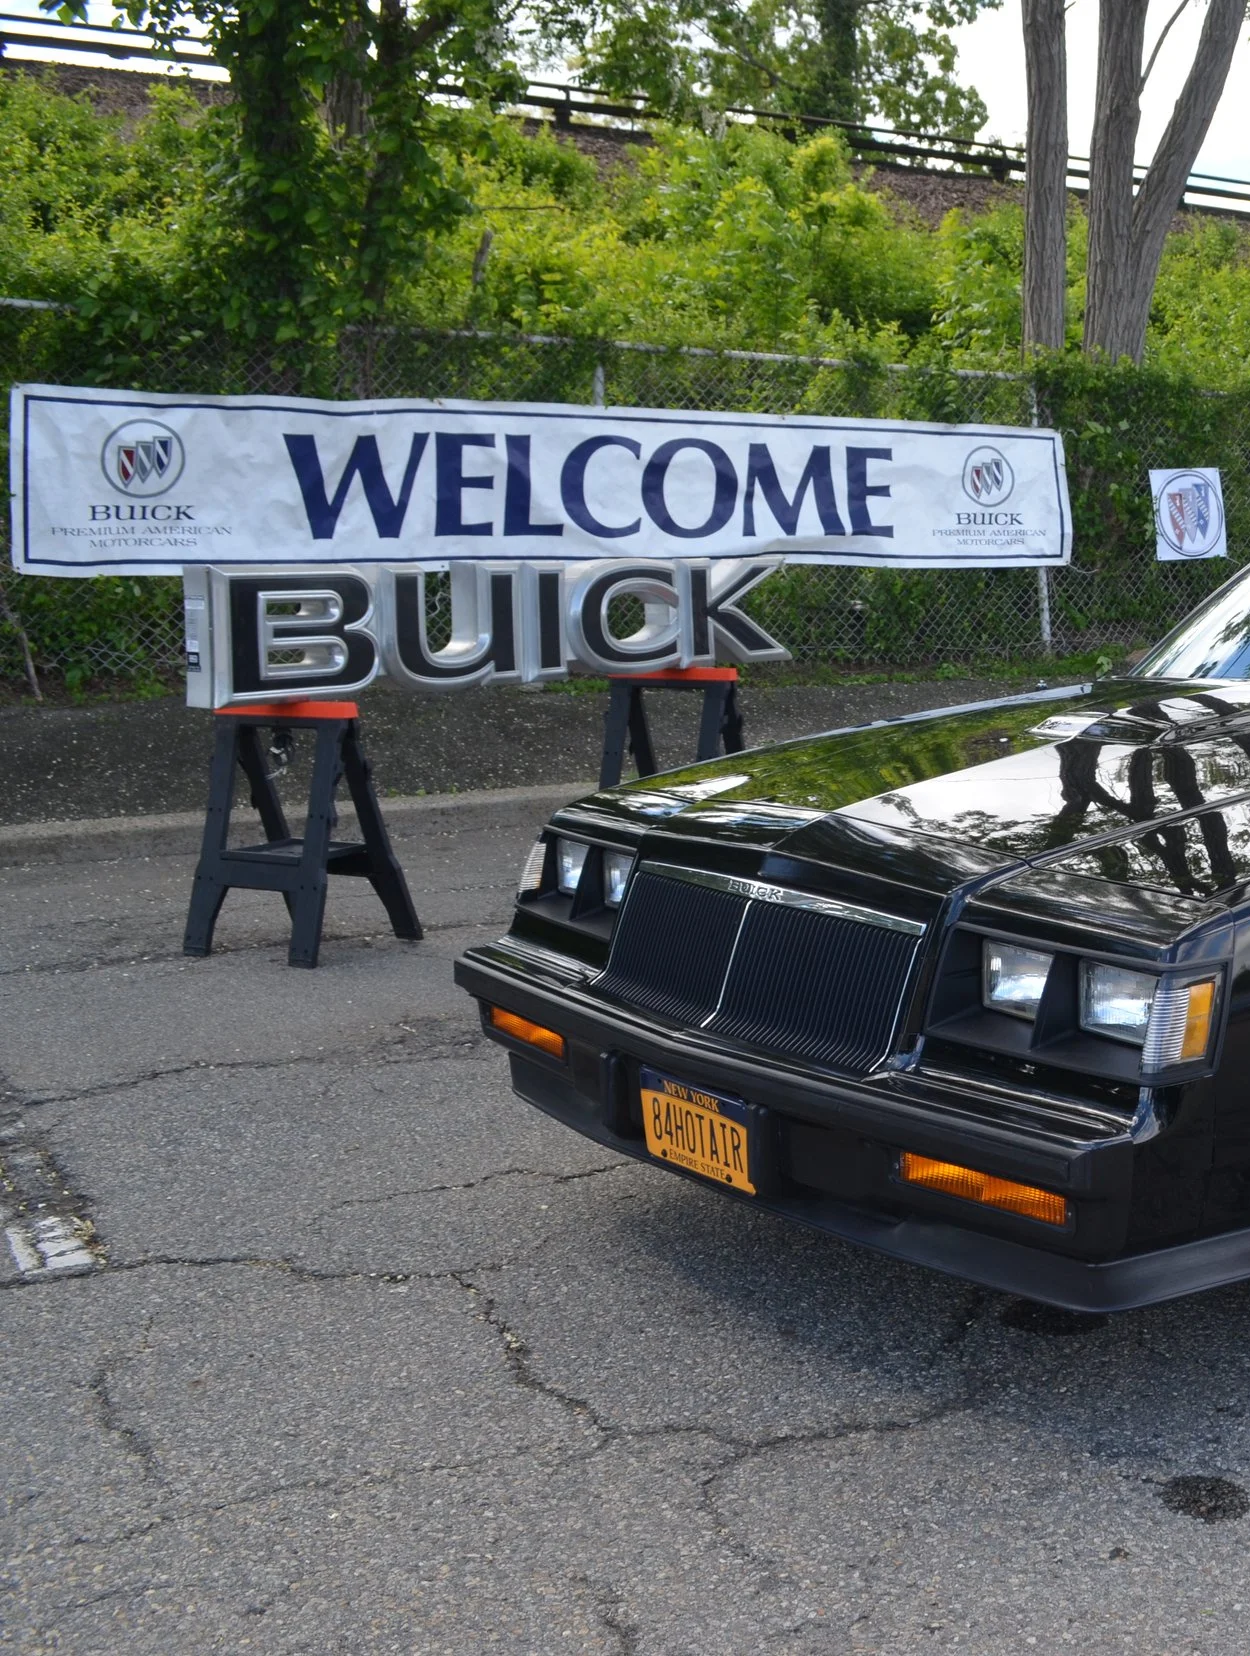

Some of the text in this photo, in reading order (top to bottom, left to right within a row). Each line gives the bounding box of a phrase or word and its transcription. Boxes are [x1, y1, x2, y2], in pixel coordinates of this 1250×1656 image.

[283, 432, 893, 539] WELCOME
[88, 505, 196, 521] BUICK
[955, 512, 1024, 526] BUICK
[51, 526, 232, 537] PREMIUM AMERICAN
[932, 529, 1047, 537] PREMIUM AMERICAN
[89, 537, 198, 549] MOTORCARS
[956, 538, 1025, 546] MOTORCARS
[205, 556, 792, 708] BUICK
[728, 879, 784, 901] BUICK
[663, 1080, 720, 1112] NEW YORK
[652, 1096, 744, 1174] 84HOTAIR
[669, 1148, 726, 1180] EMPIRE STATE
